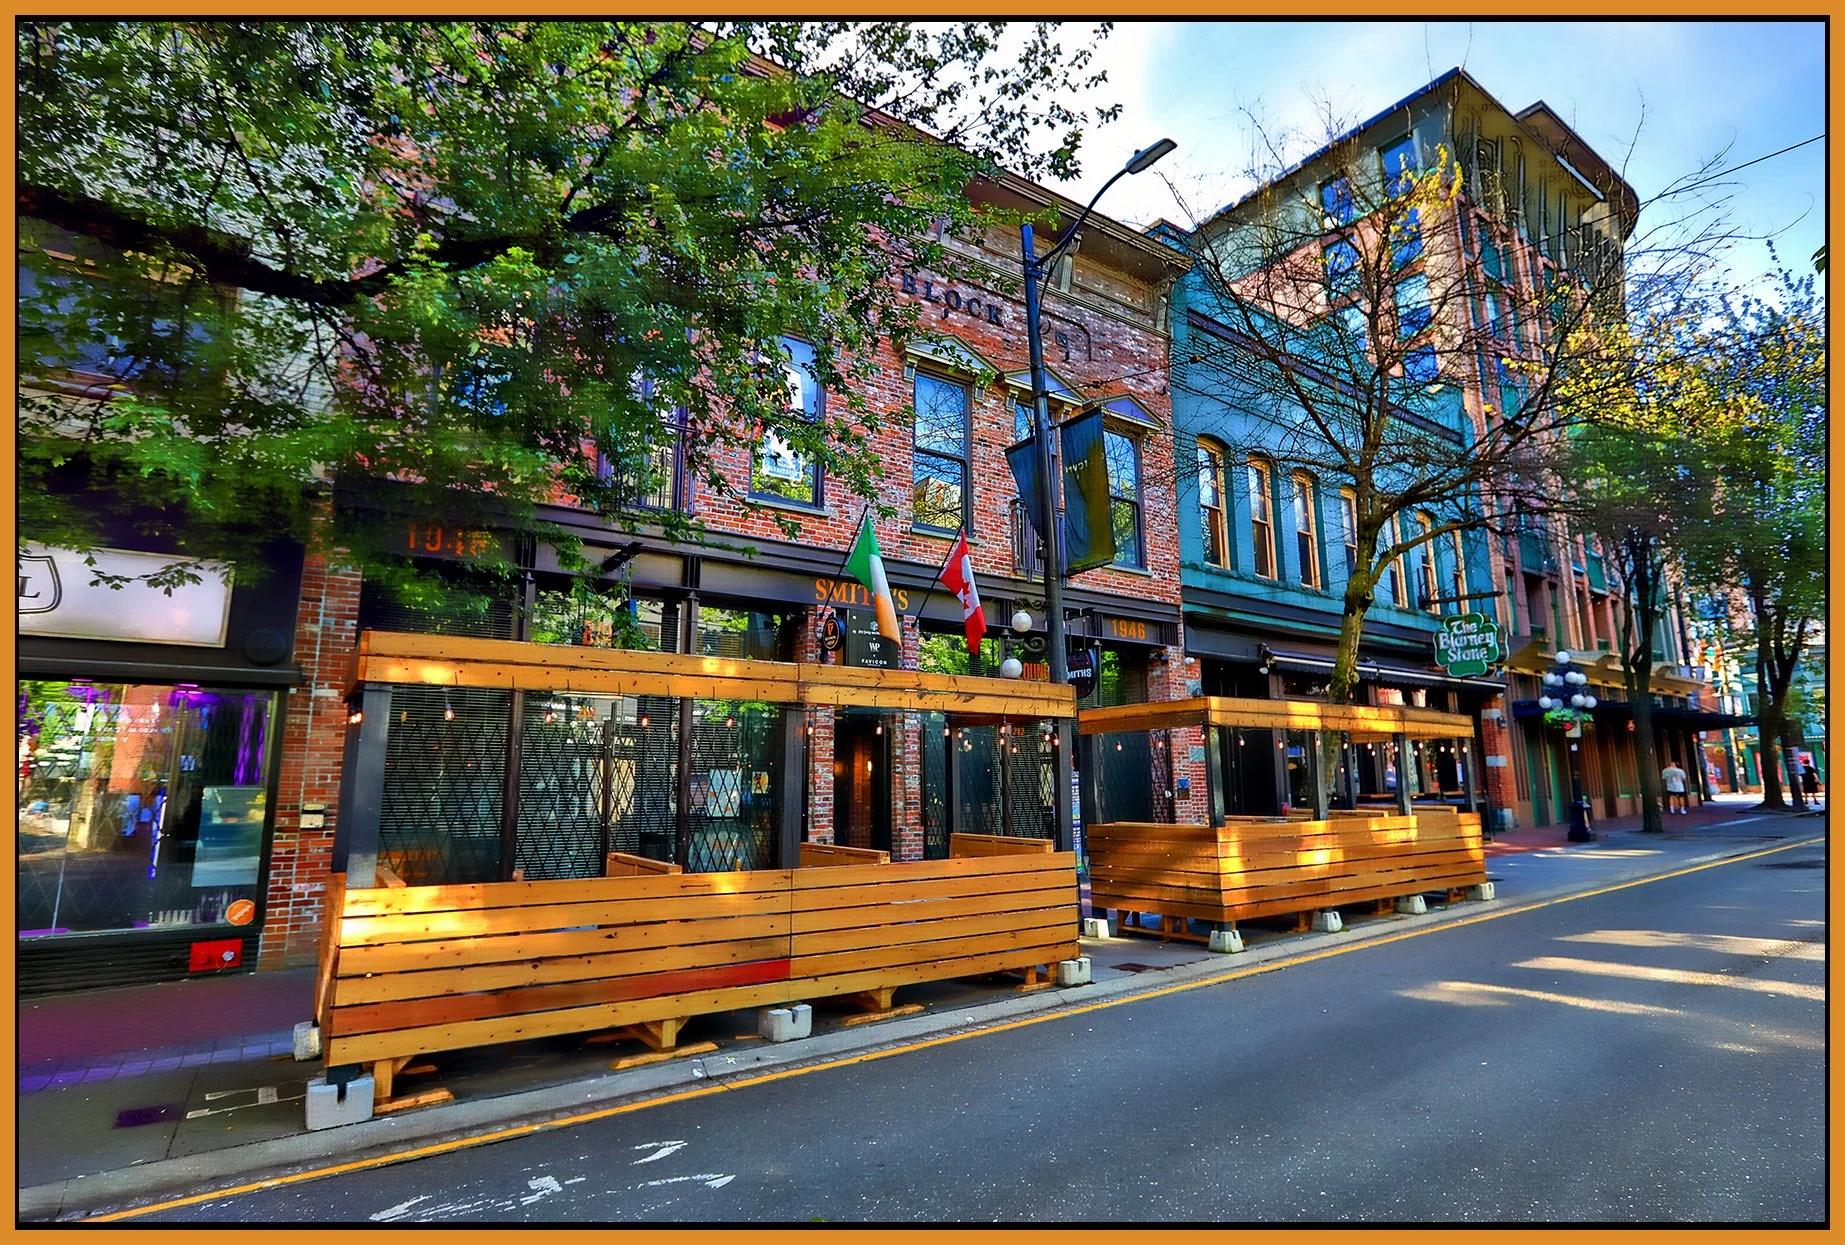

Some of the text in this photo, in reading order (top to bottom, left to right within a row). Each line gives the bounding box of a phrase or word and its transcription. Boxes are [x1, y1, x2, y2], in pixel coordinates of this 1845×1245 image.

[902, 273, 1005, 328] BLOCK
[815, 578, 909, 610] SMIT'S
[1111, 619, 1147, 640] 1946
[1450, 620, 1478, 634] The
[1439, 631, 1495, 649] Blarney
[1447, 647, 1488, 662] Stone
[1067, 668, 1092, 679] MITHS
